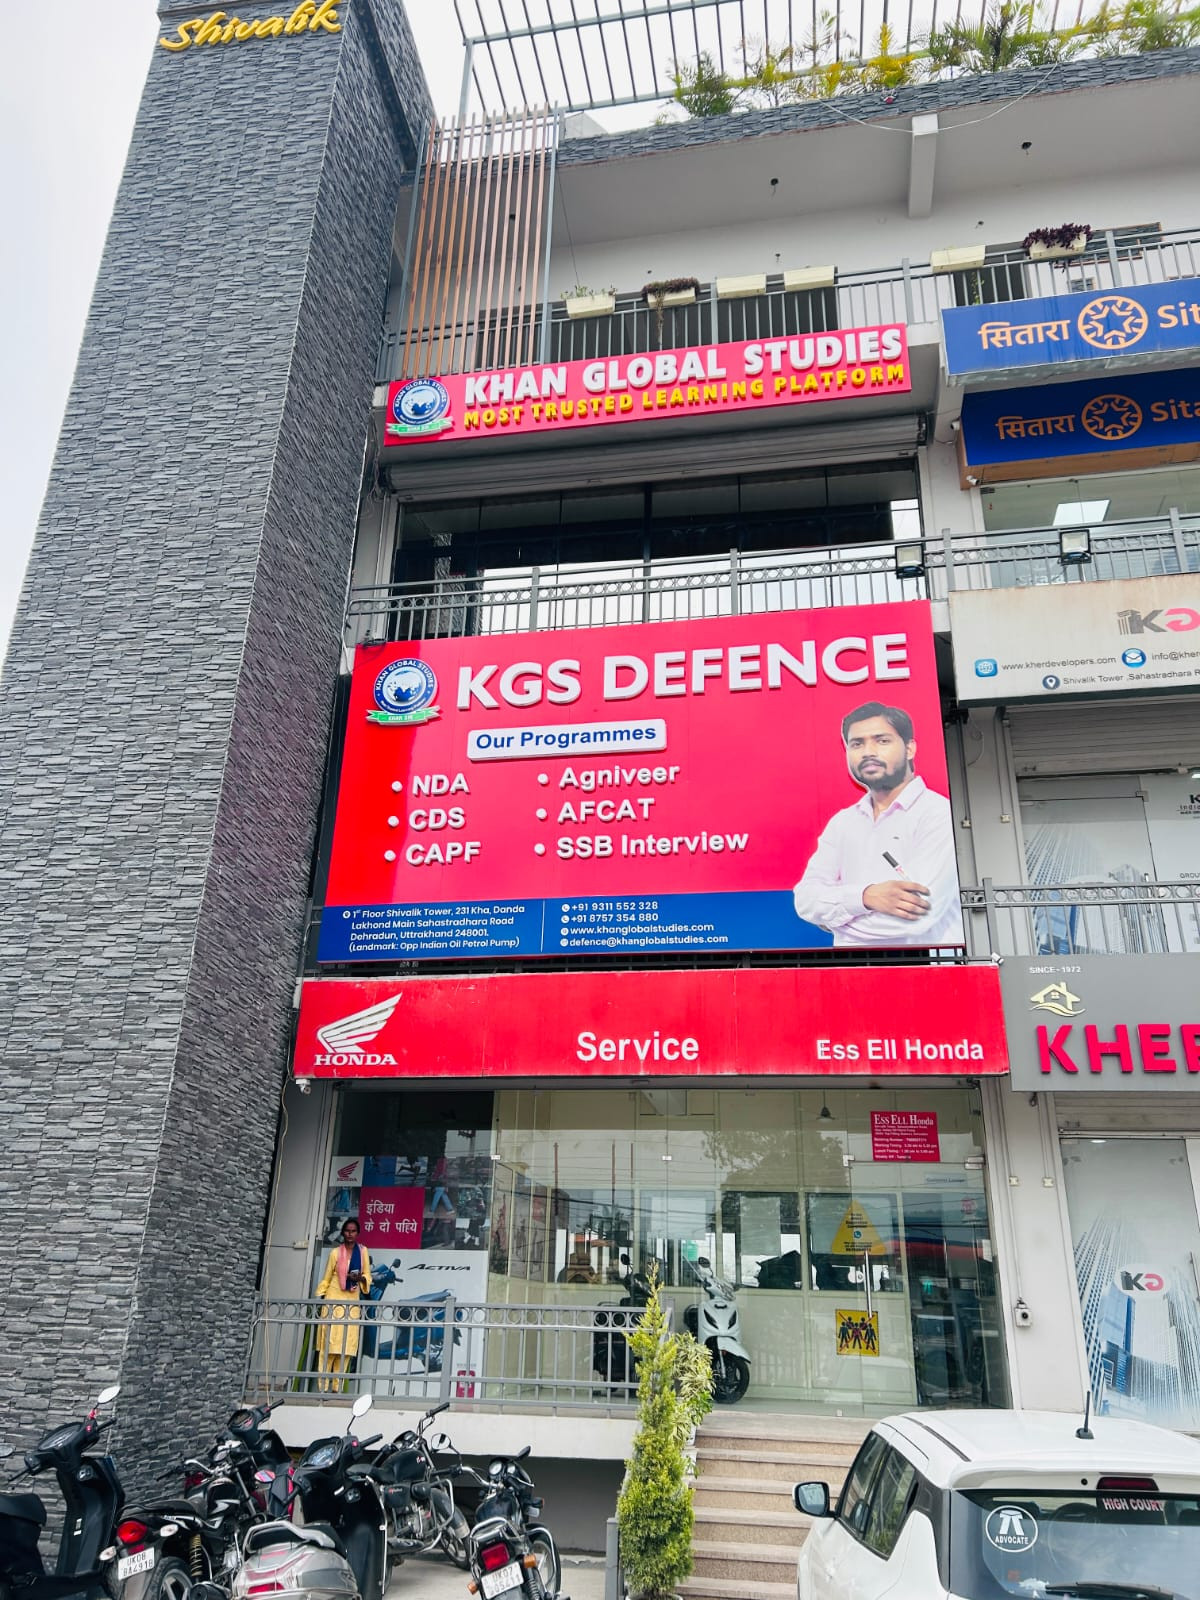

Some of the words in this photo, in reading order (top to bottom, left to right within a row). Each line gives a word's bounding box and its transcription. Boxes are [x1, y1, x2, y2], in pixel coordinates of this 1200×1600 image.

[159, 0, 342, 51] Shivalik
[978, 319, 1071, 349] सितारा
[465, 366, 567, 406] KHAN
[583, 349, 726, 392] GLOBAL
[744, 329, 902, 375] STUDIES
[464, 405, 523, 428] MOST
[531, 394, 633, 420] TRUSTED
[642, 379, 764, 409] LEARNING
[775, 364, 904, 393] PLATFORM
[995, 414, 1075, 440] सितारा
[457, 659, 582, 710] KGS
[603, 633, 910, 701] DEFENCE
[1001, 655, 1117, 671] www.kherdevelopers.com
[375, 669, 389, 690] KHAN
[388, 660, 417, 671] GLOBAL
[416, 663, 434, 688] STUDIES
[1063, 675, 1096, 685] Shivalik
[1098, 674, 1123, 683] Tower
[476, 735, 514, 749] Our
[520, 725, 656, 748] Programmes
[412, 773, 470, 796] NDA
[559, 765, 680, 791] Agniveer
[409, 807, 466, 830] CDS
[557, 798, 655, 823] AFCAT
[405, 841, 481, 866] CAPF
[556, 836, 613, 858] SSB
[621, 832, 749, 856] Interview
[362, 909, 384, 918] Floor
[386, 907, 422, 917] Shivalik
[423, 907, 454, 917] Tower,
[455, 906, 470, 915] 231
[471, 906, 492, 916] Kha,
[493, 905, 525, 914] Danda
[572, 903, 588, 911] +91
[591, 902, 613, 911] 9311
[616, 902, 636, 910] 552
[638, 901, 658, 910] 328
[351, 920, 391, 930] Lakhond
[392, 919, 415, 928] Main
[417, 917, 488, 928] Sahastradhara
[489, 916, 514, 926] Road
[571, 914, 587, 923] +91
[589, 914, 614, 922] 8757
[616, 913, 636, 922] 354
[400, 929, 453, 939] Uttrakhand
[570, 923, 715, 936] www.khanglobalstudies.com
[400, 941, 418, 951] Opp
[420, 940, 448, 949] Indian
[449, 939, 461, 948] Oil
[462, 938, 488, 948] Petrol
[489, 937, 520, 949] Pump)
[570, 935, 729, 947] defence@khanglobalstudies.com
[577, 1030, 699, 1062] Service
[816, 1039, 860, 1060] Ess
[867, 1039, 897, 1060] Ell
[905, 1038, 984, 1060] Honda
[314, 1054, 398, 1066] HONDA
[909, 1114, 934, 1126] Honda
[366, 1199, 395, 1215] इंडिया
[364, 1218, 374, 1233] के
[379, 1218, 391, 1233] दो
[395, 1218, 418, 1234] पहिये
[1102, 1497, 1129, 1511] HIGH
[1130, 1499, 1164, 1512] COURT
[995, 1535, 1029, 1545] ADVOCATE
